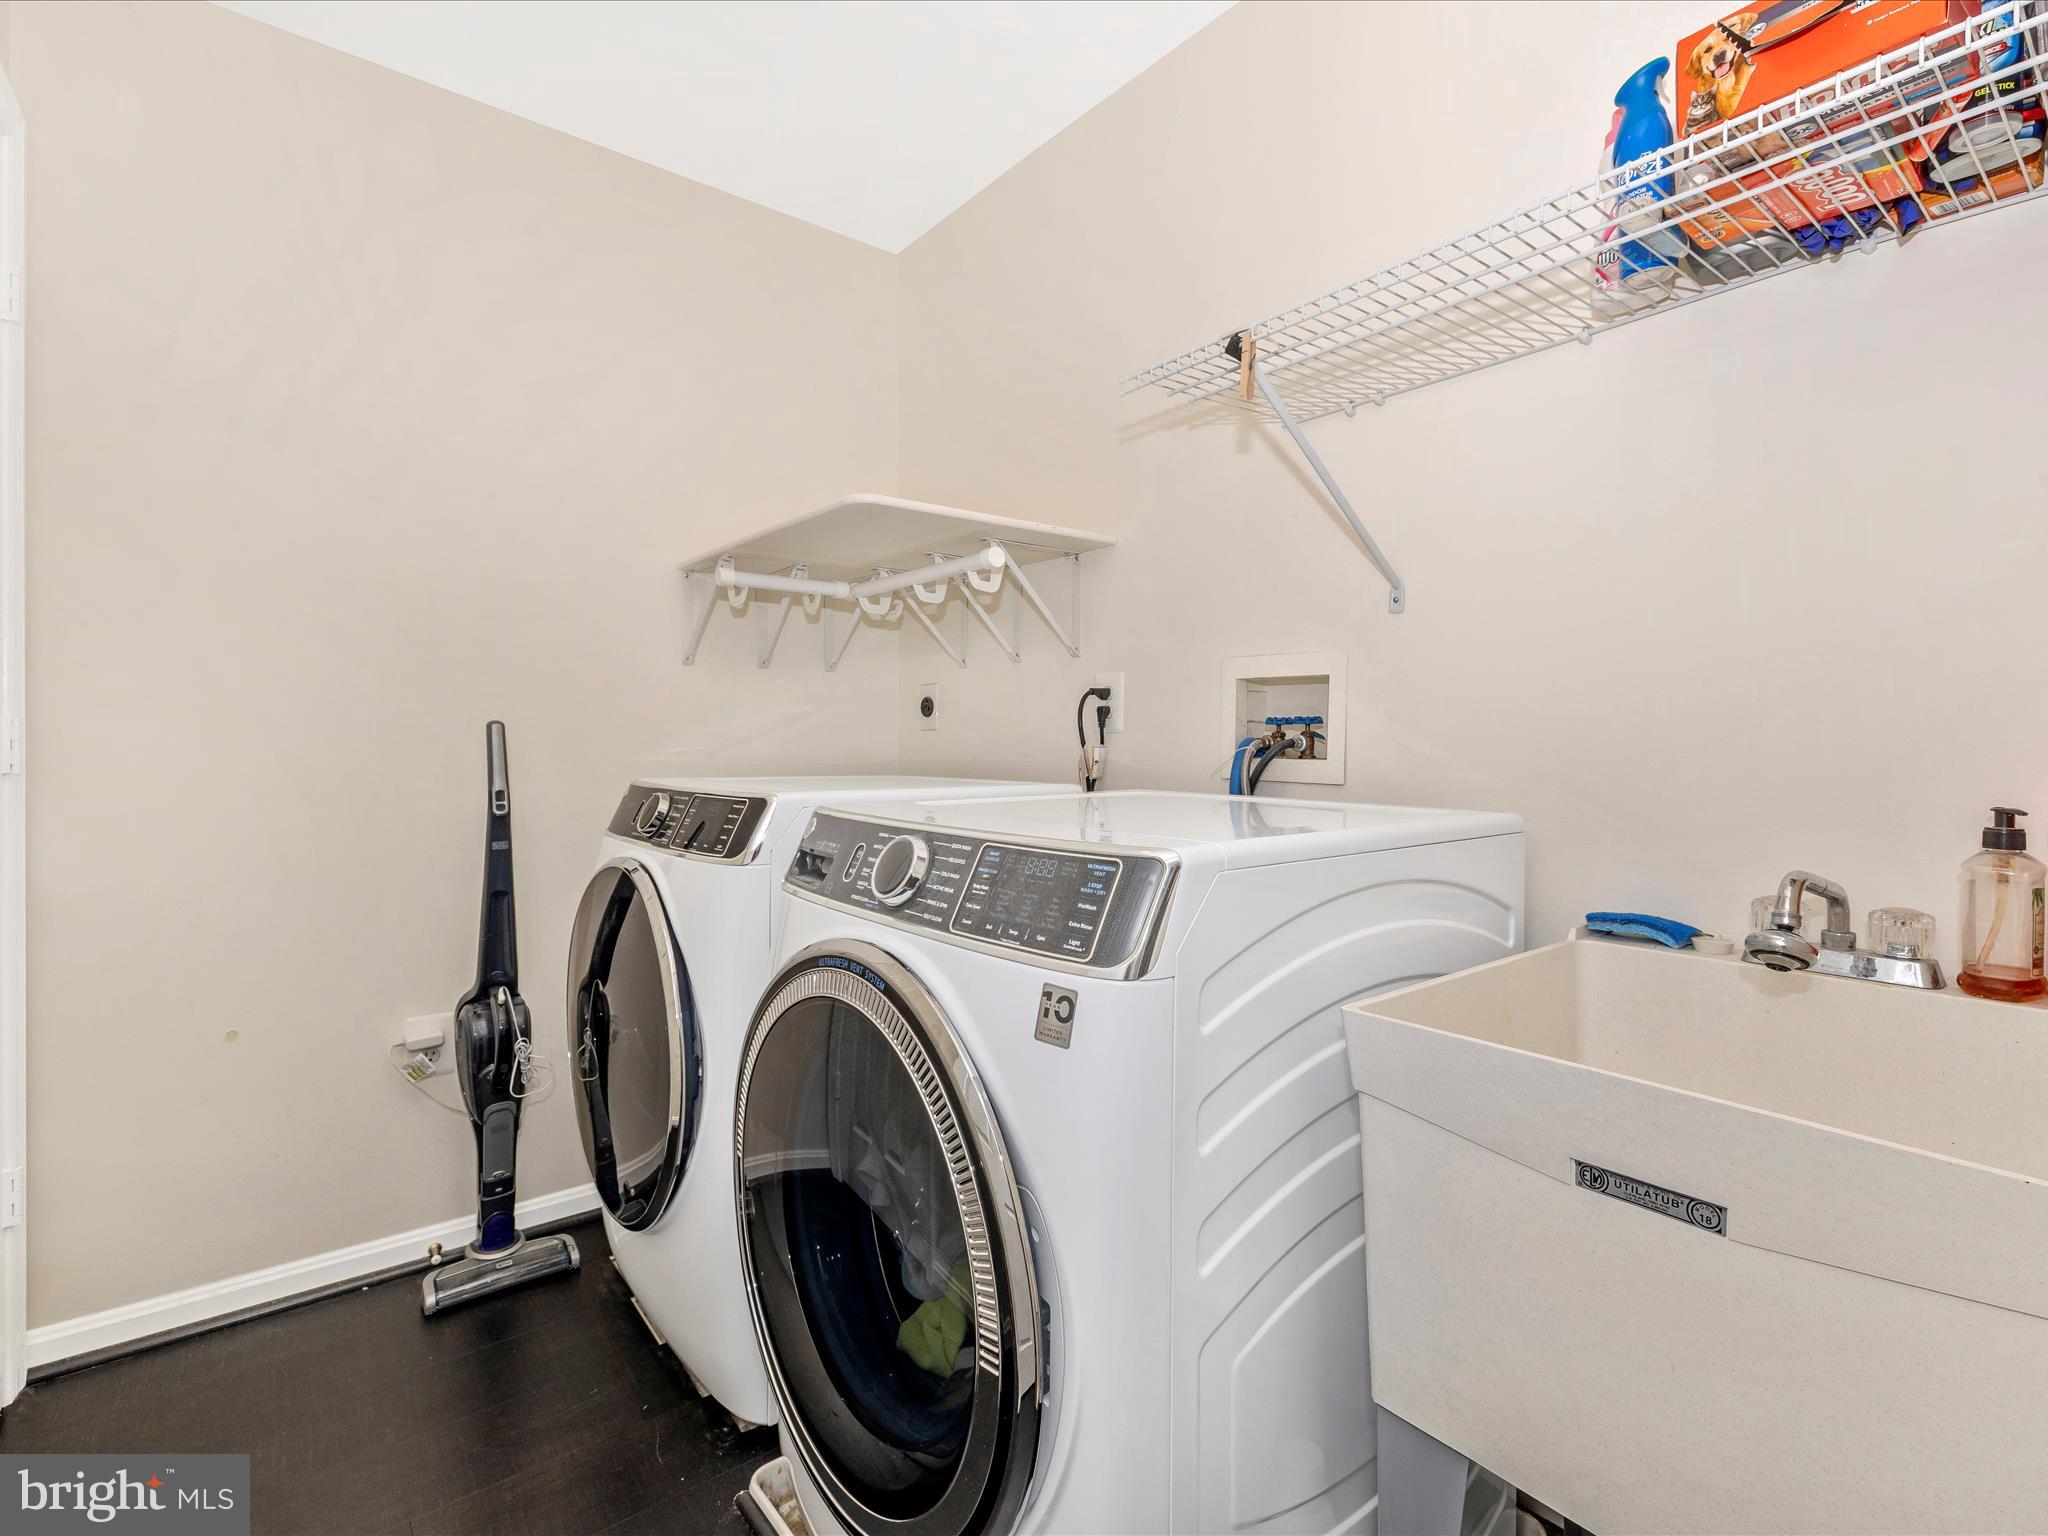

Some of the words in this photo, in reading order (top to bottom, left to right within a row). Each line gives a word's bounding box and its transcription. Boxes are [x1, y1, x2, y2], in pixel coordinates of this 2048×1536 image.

[1974, 86, 1991, 97] GEL
[1995, 81, 2015, 91] TICK
[1068, 920, 1080, 928] Extra
[1068, 938, 1081, 947] Light
[818, 957, 848, 969] ULTRAFRESH
[850, 961, 864, 975] VENT
[864, 969, 886, 992] SYSTEM
[1042, 990, 1075, 1024] 10
[1039, 1031, 1066, 1042] WARRANTY
[1043, 1025, 1063, 1036] LIMITED
[1614, 1180, 1680, 1209] UTILATUB
[1694, 1204, 1717, 1218] MODEL
[1699, 1213, 1713, 1226] 18
